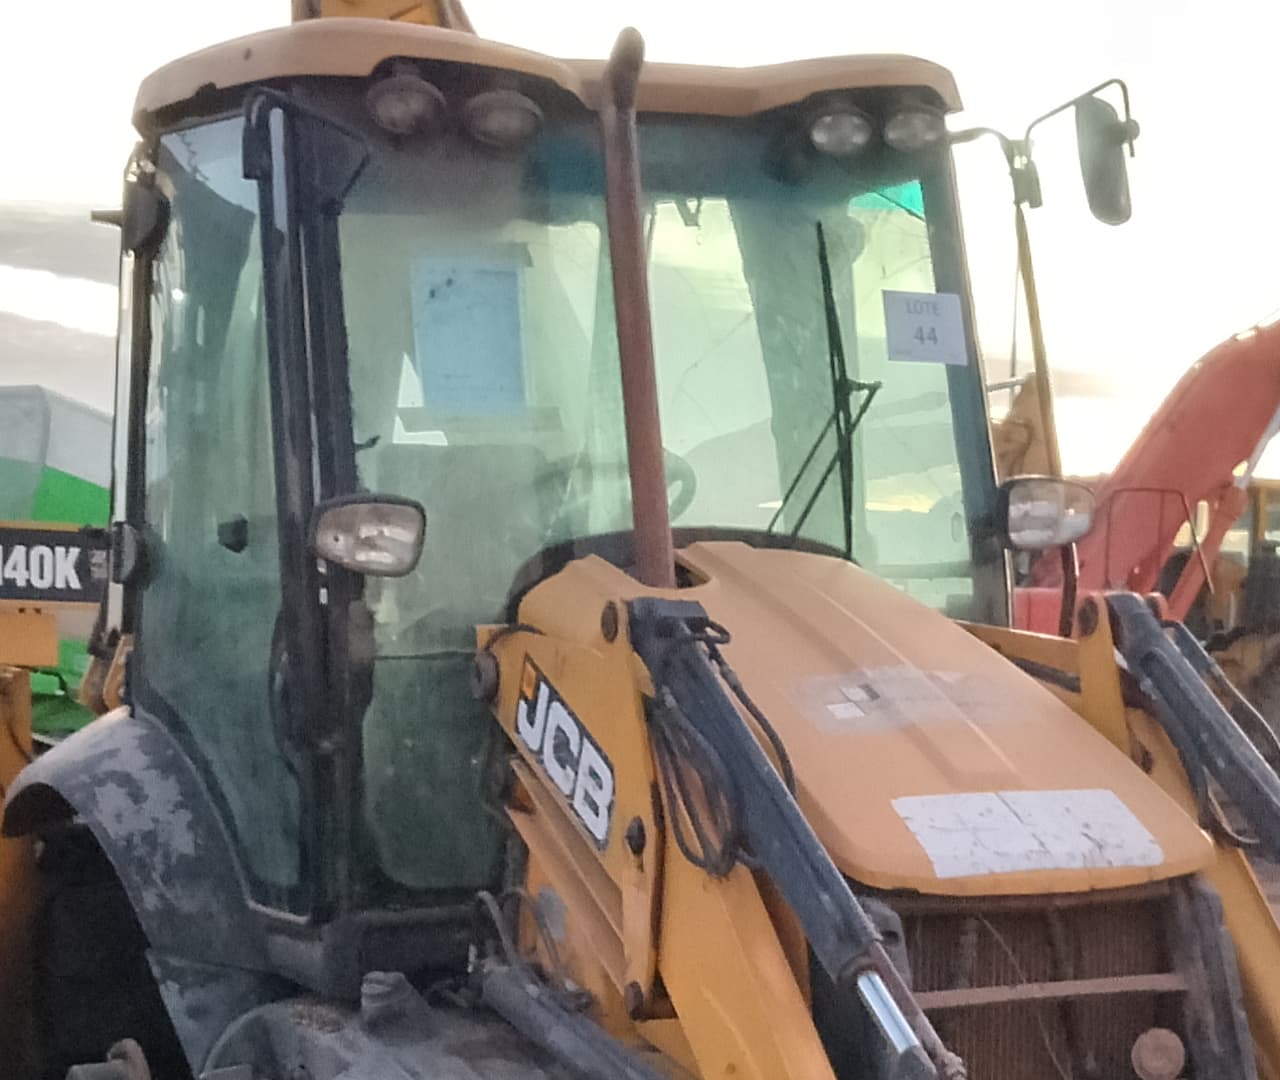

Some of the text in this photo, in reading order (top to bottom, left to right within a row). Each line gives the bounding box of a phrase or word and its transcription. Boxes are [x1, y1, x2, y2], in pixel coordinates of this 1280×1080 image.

[905, 301, 940, 316] LOTE
[914, 326, 938, 345] 44
[517, 680, 614, 841] JCB
